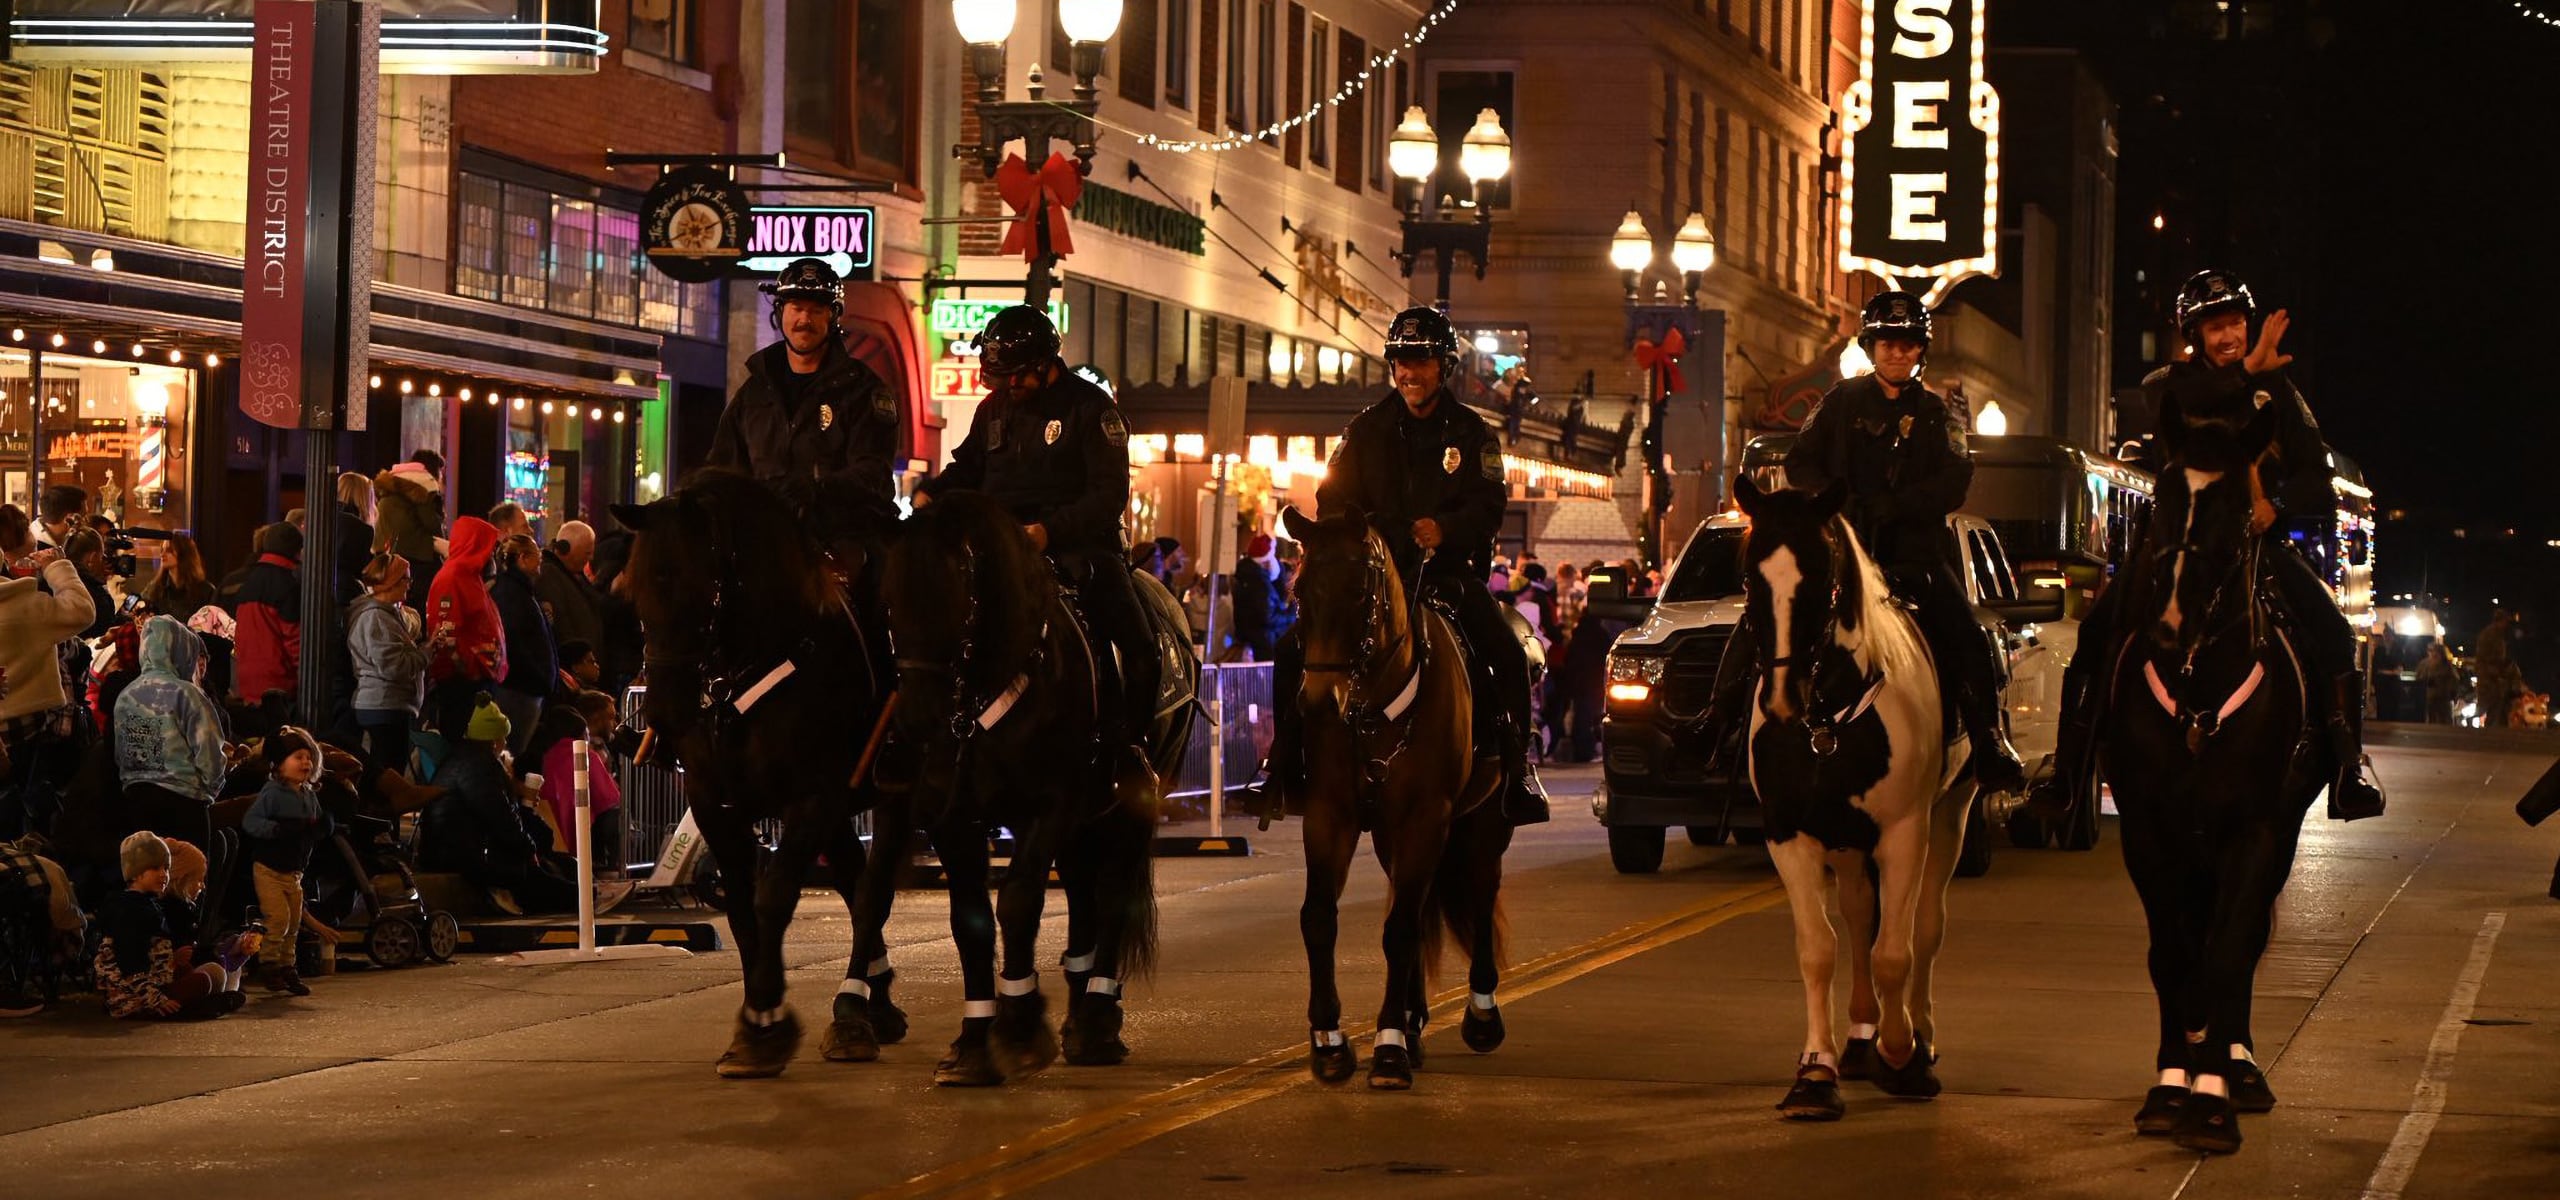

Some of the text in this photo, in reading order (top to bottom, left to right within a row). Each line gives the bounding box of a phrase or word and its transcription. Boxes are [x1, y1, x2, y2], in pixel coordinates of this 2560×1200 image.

[263, 21, 293, 298] THEATRE DISTRICT
[814, 216, 865, 253] BOX
